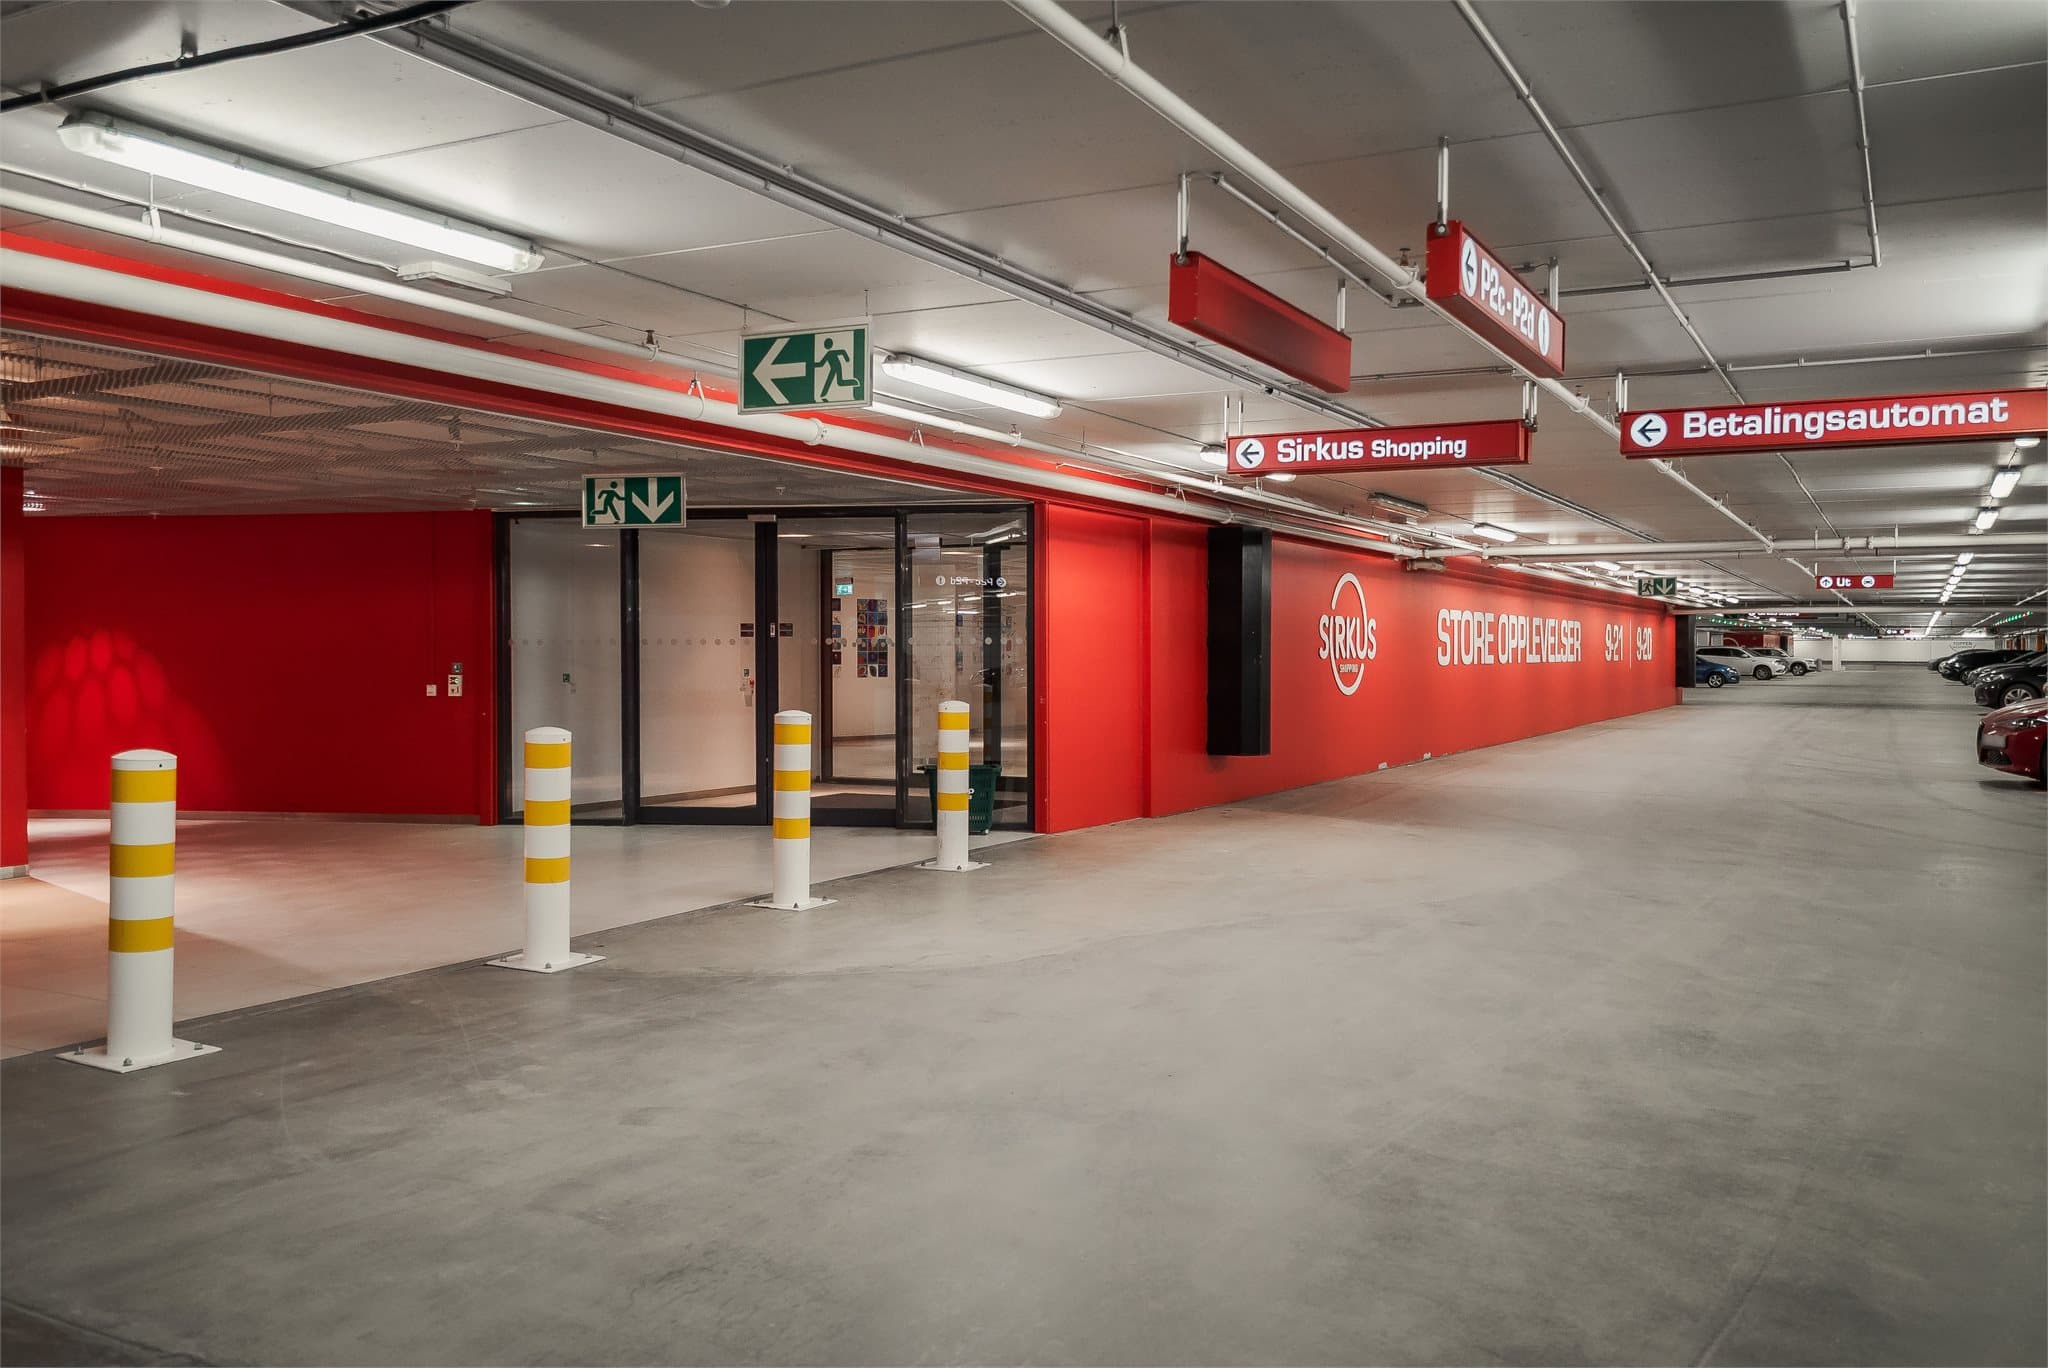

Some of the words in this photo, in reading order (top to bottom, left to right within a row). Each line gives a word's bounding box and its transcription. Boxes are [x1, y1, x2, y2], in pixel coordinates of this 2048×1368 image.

[1682, 396, 2009, 439] Betalingsautomat
[1277, 437, 1364, 463] Sirkus
[1371, 436, 1467, 460] Shopping
[1836, 576, 1851, 587] Ut
[1319, 614, 1377, 660] SIRKUS
[1437, 608, 1495, 666] STORE
[1498, 613, 1582, 664] OPPLEVELSER
